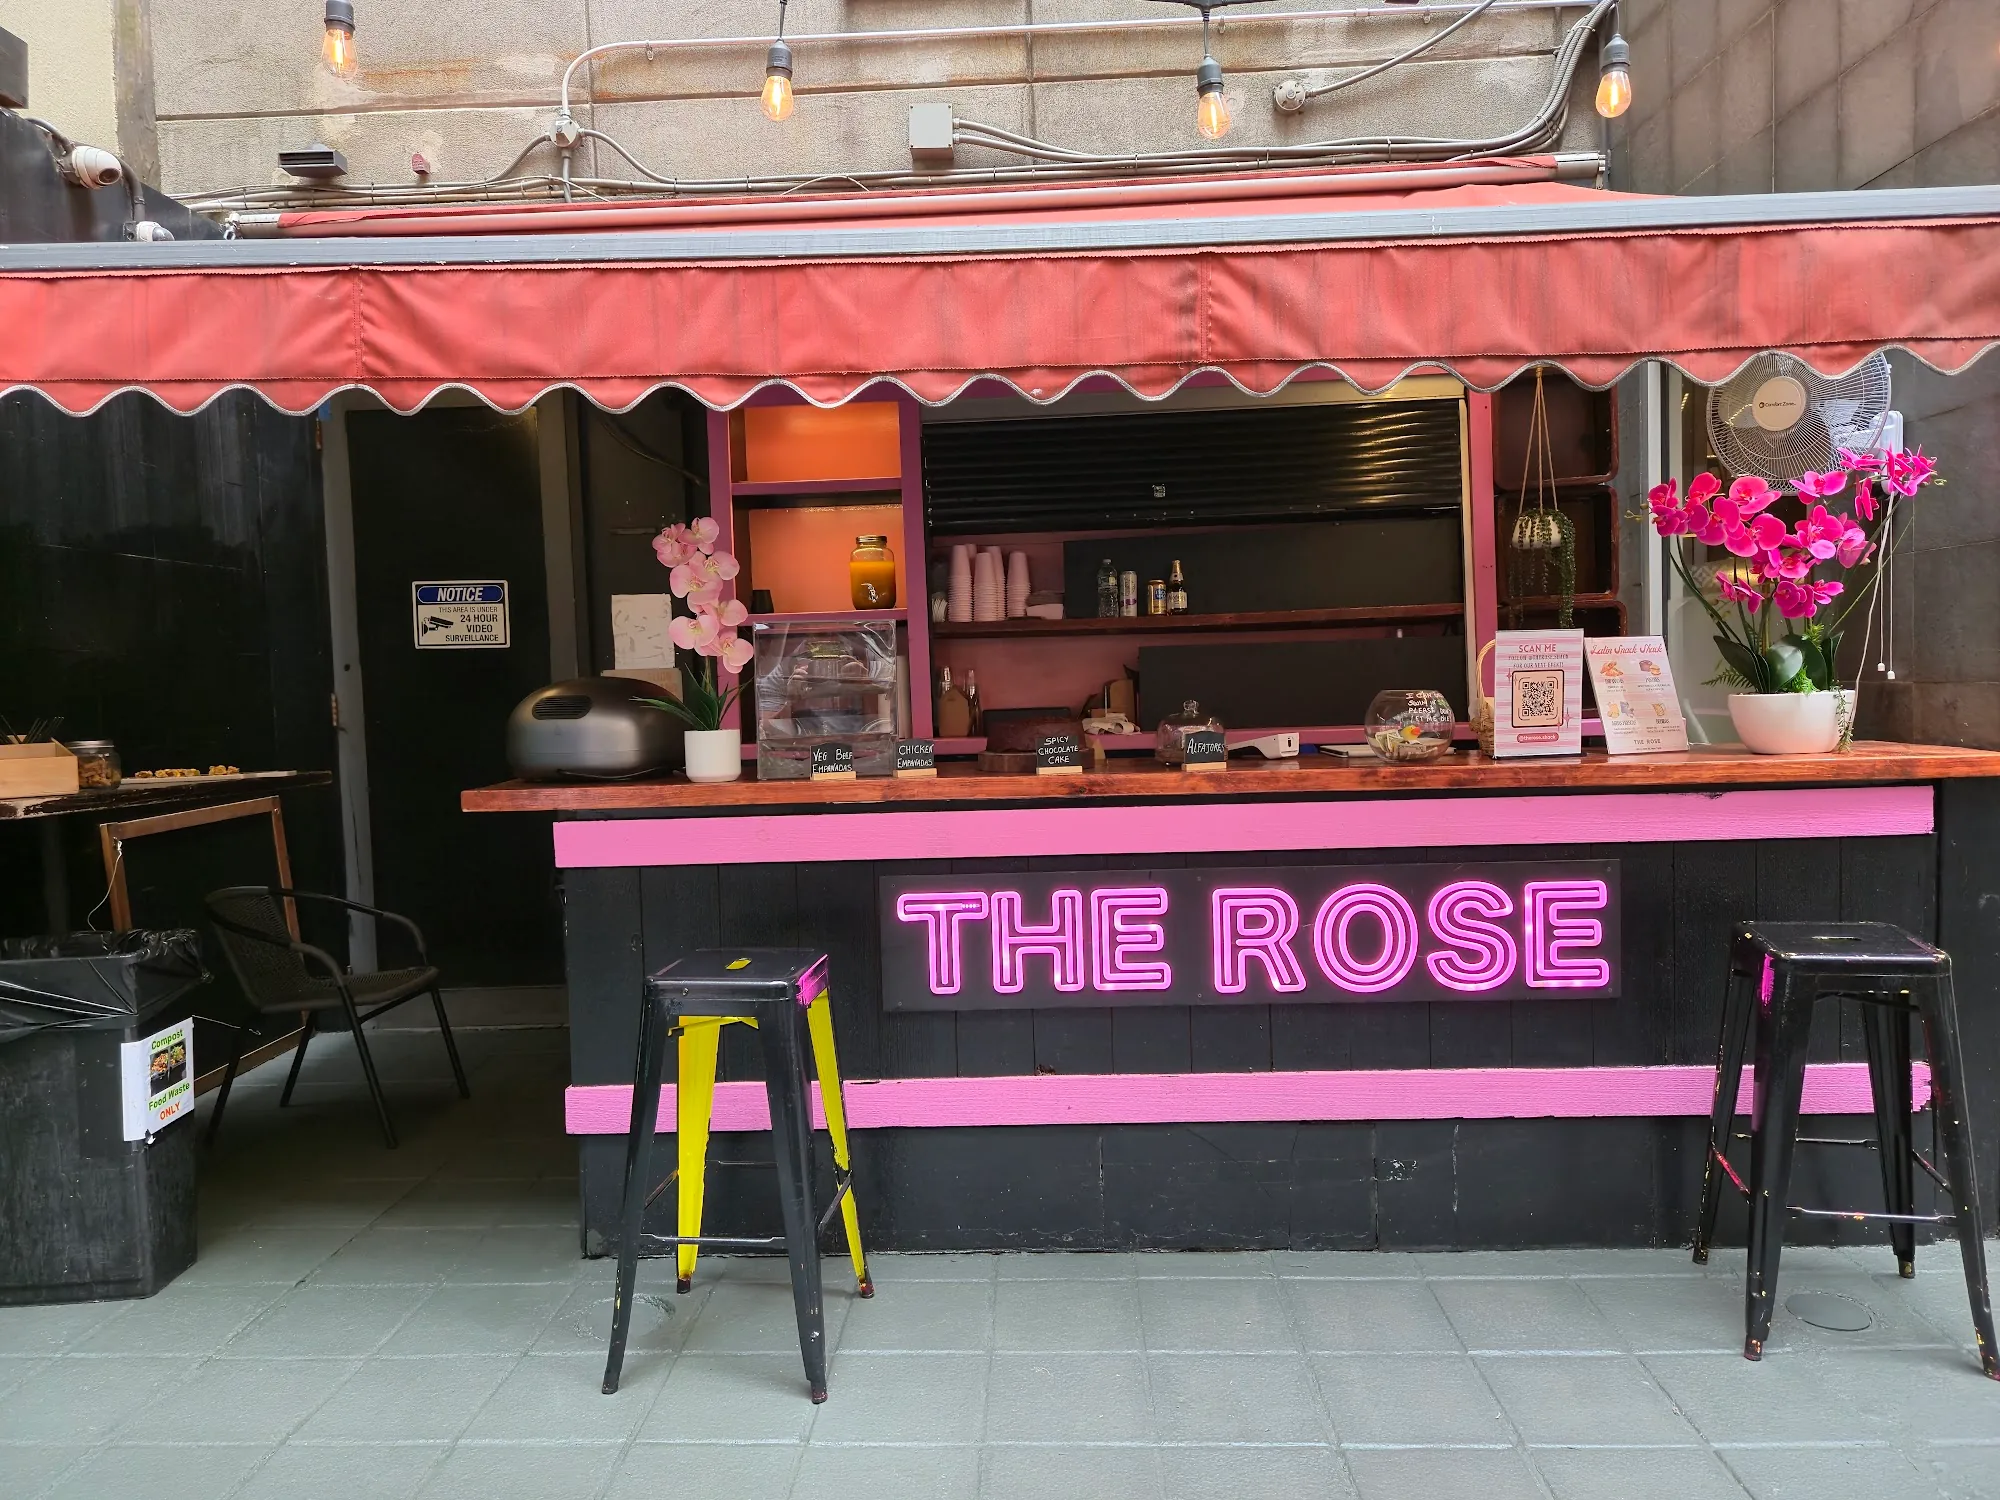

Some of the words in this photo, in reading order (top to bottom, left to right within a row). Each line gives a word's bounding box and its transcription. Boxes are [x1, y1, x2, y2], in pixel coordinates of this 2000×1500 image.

[437, 587, 484, 602] NOTICE
[460, 614, 471, 623] 24
[473, 614, 498, 623] HOUR
[466, 624, 493, 633] VIDEO
[445, 634, 499, 642] SURVEILLANCE
[1518, 644, 1542, 653] SCAN
[1544, 643, 1557, 652] ME
[1043, 736, 1069, 746] SPICY
[1186, 737, 1225, 755] ALFAJORES
[813, 748, 828, 762] VEG
[898, 743, 935, 756] CHICKEN
[1037, 745, 1079, 756] CHOCOLATE
[1047, 755, 1070, 765] CAKE
[896, 886, 1170, 994] THE
[1211, 880, 1610, 994] ROSE
[151, 1029, 183, 1050] Compost
[148, 1093, 167, 1111] Food
[168, 1081, 190, 1100] Waste
[159, 1101, 181, 1121] ONLY
